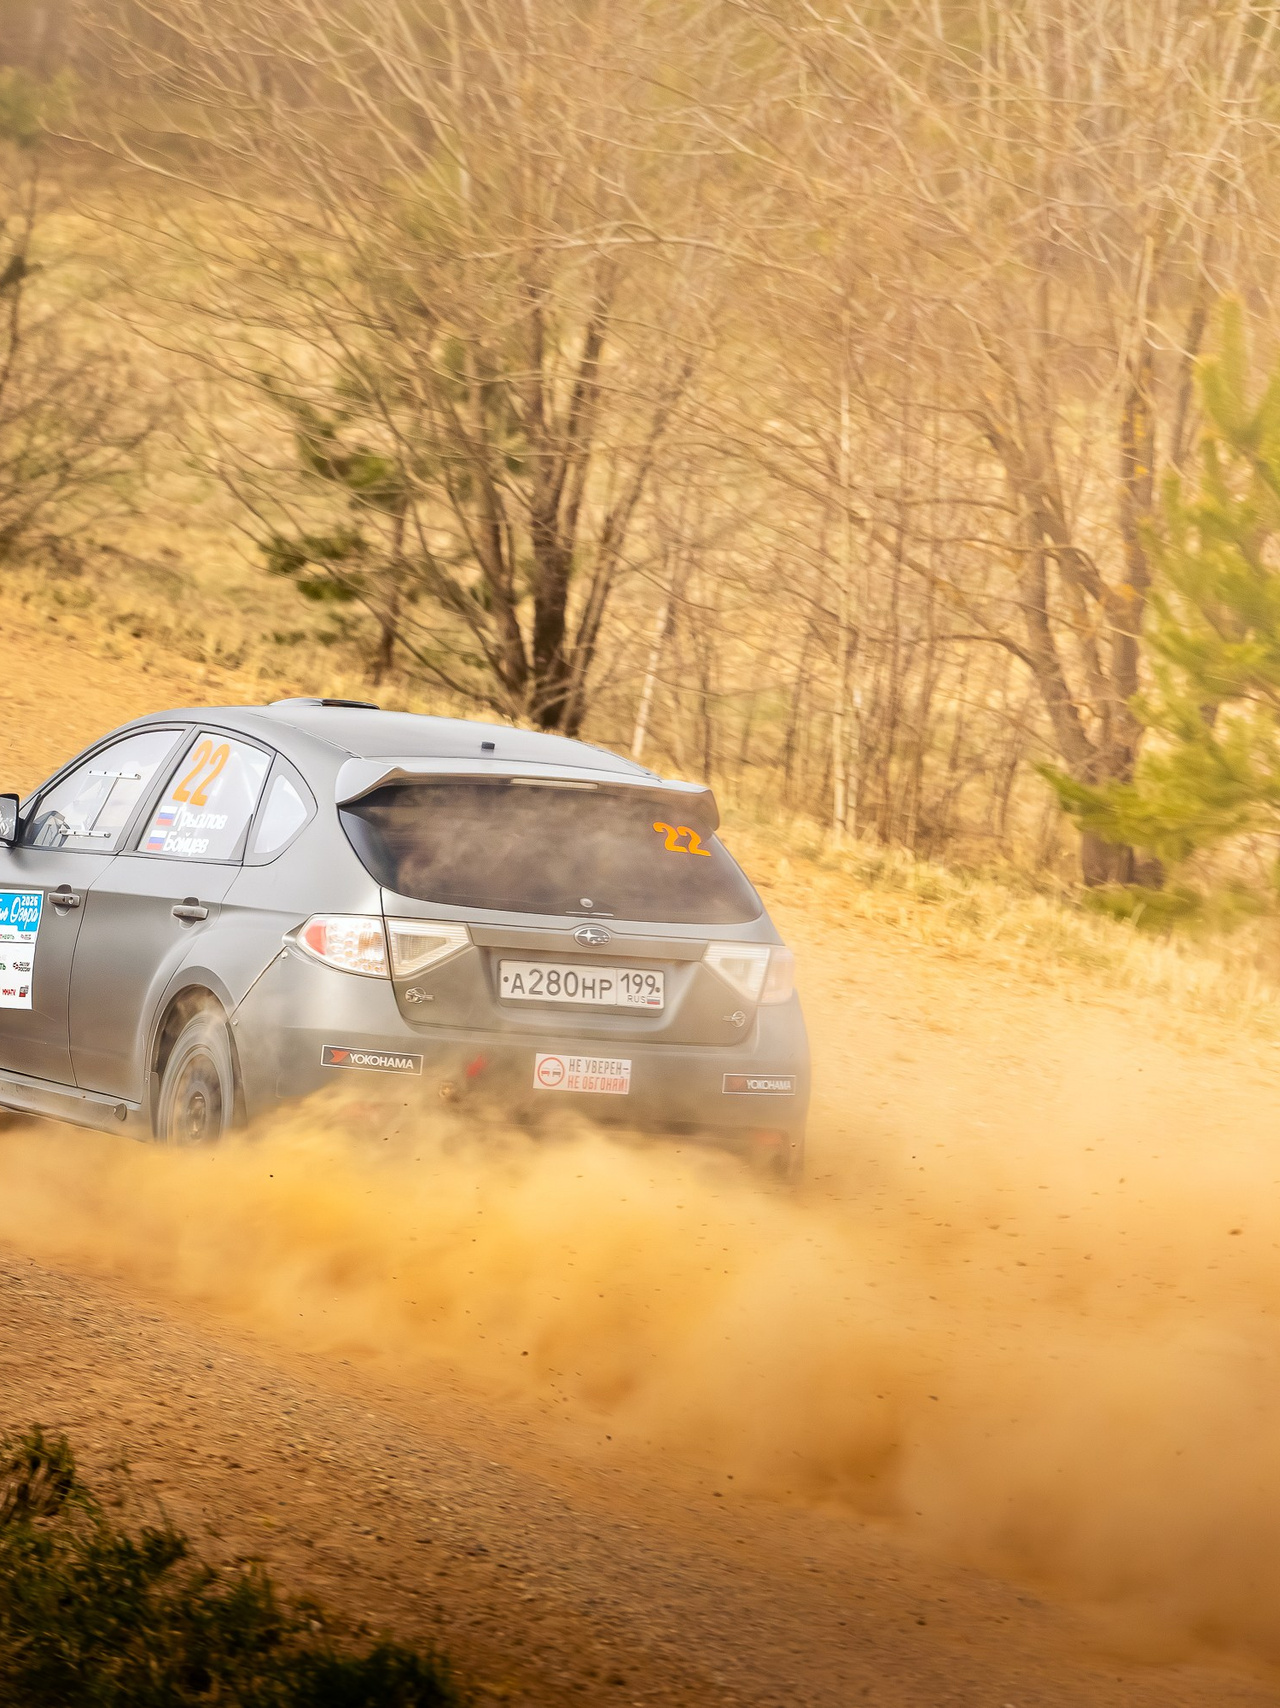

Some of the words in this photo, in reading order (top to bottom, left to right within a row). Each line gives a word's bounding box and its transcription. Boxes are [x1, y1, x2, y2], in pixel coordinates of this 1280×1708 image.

[172, 739, 231, 806] 22
[653, 821, 711, 857] 22
[22, 895, 38, 906] 2026
[511, 968, 613, 1000] А280НР
[620, 973, 656, 996] 199
[628, 994, 646, 1004] RUS
[349, 1053, 414, 1070] YOKOHAMA
[569, 1058, 581, 1073] НЕ
[567, 1075, 580, 1089] НЕ
[582, 1076, 629, 1093] ОБГОНЯЙ!
[746, 1079, 792, 1090] YOKOHAMA
